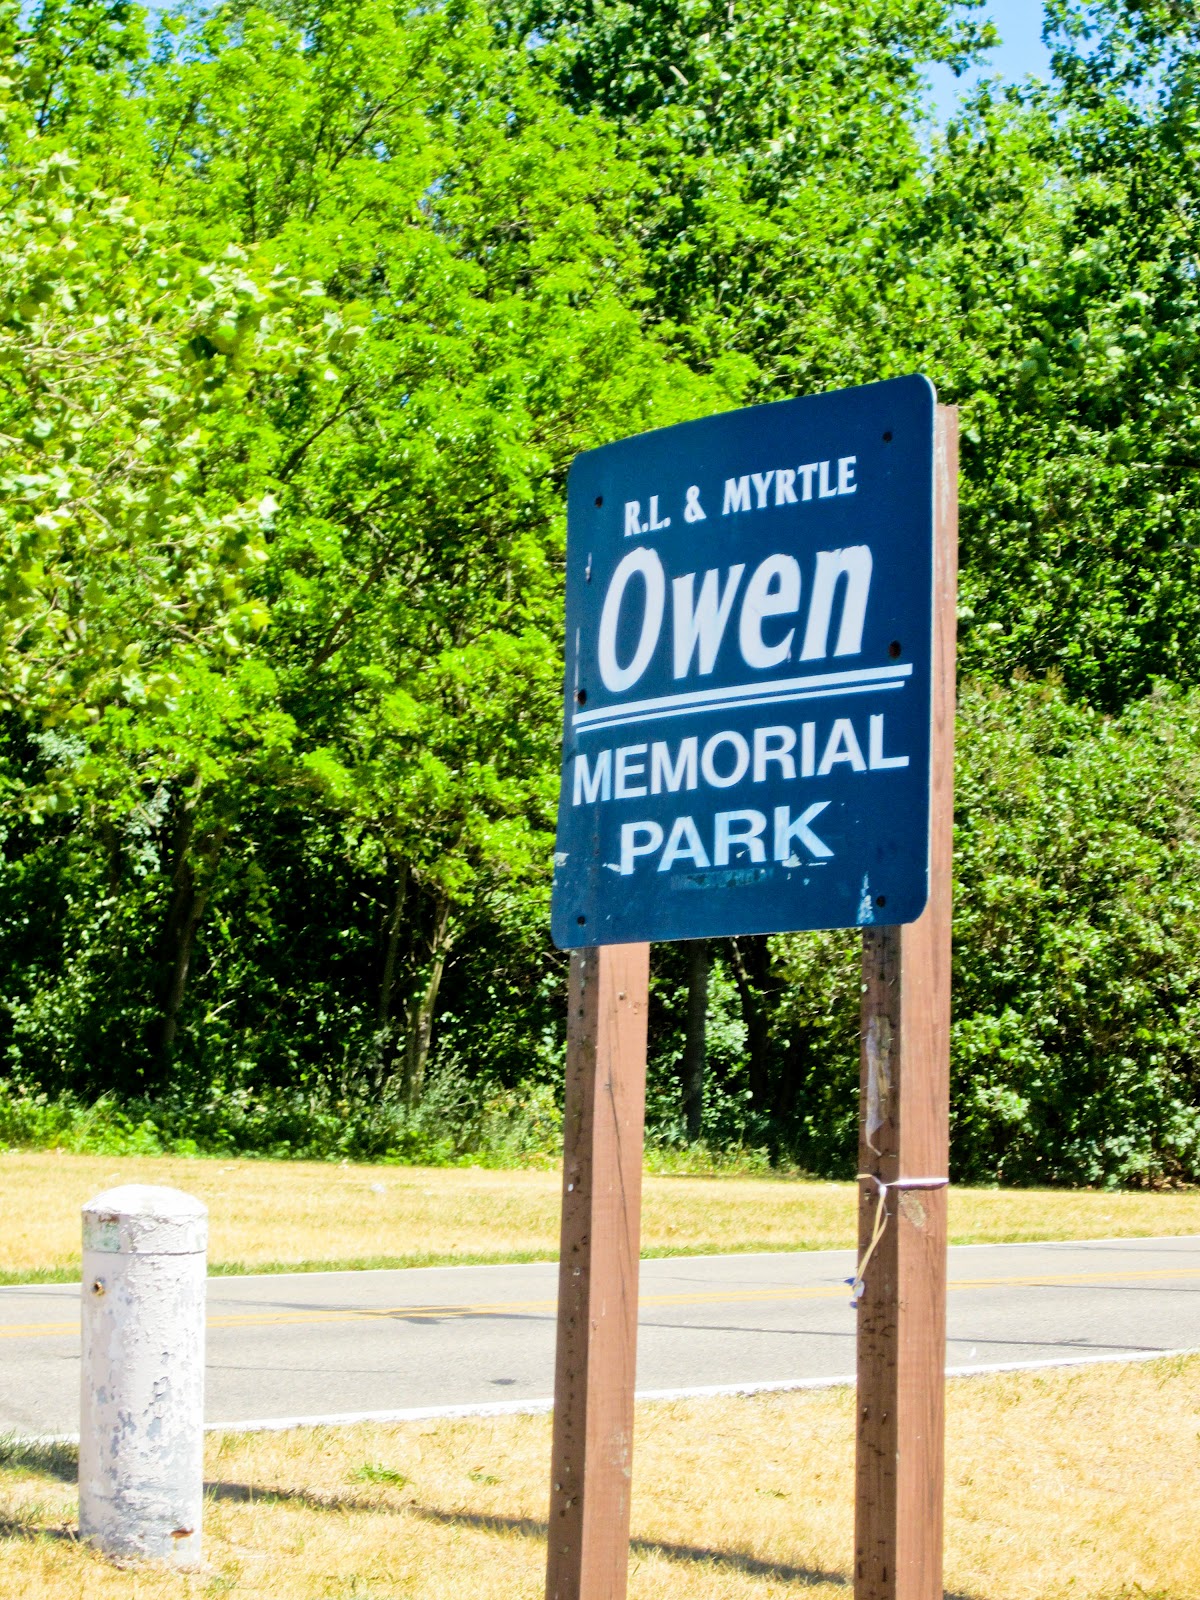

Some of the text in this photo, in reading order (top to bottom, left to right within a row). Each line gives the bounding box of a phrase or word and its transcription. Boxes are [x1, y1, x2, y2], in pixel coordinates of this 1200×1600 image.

[623, 455, 858, 538] R.L. & MYRTLE
[597, 544, 873, 693] Owen
[572, 713, 910, 807] MEMORIAL
[619, 800, 834, 876] PARK
